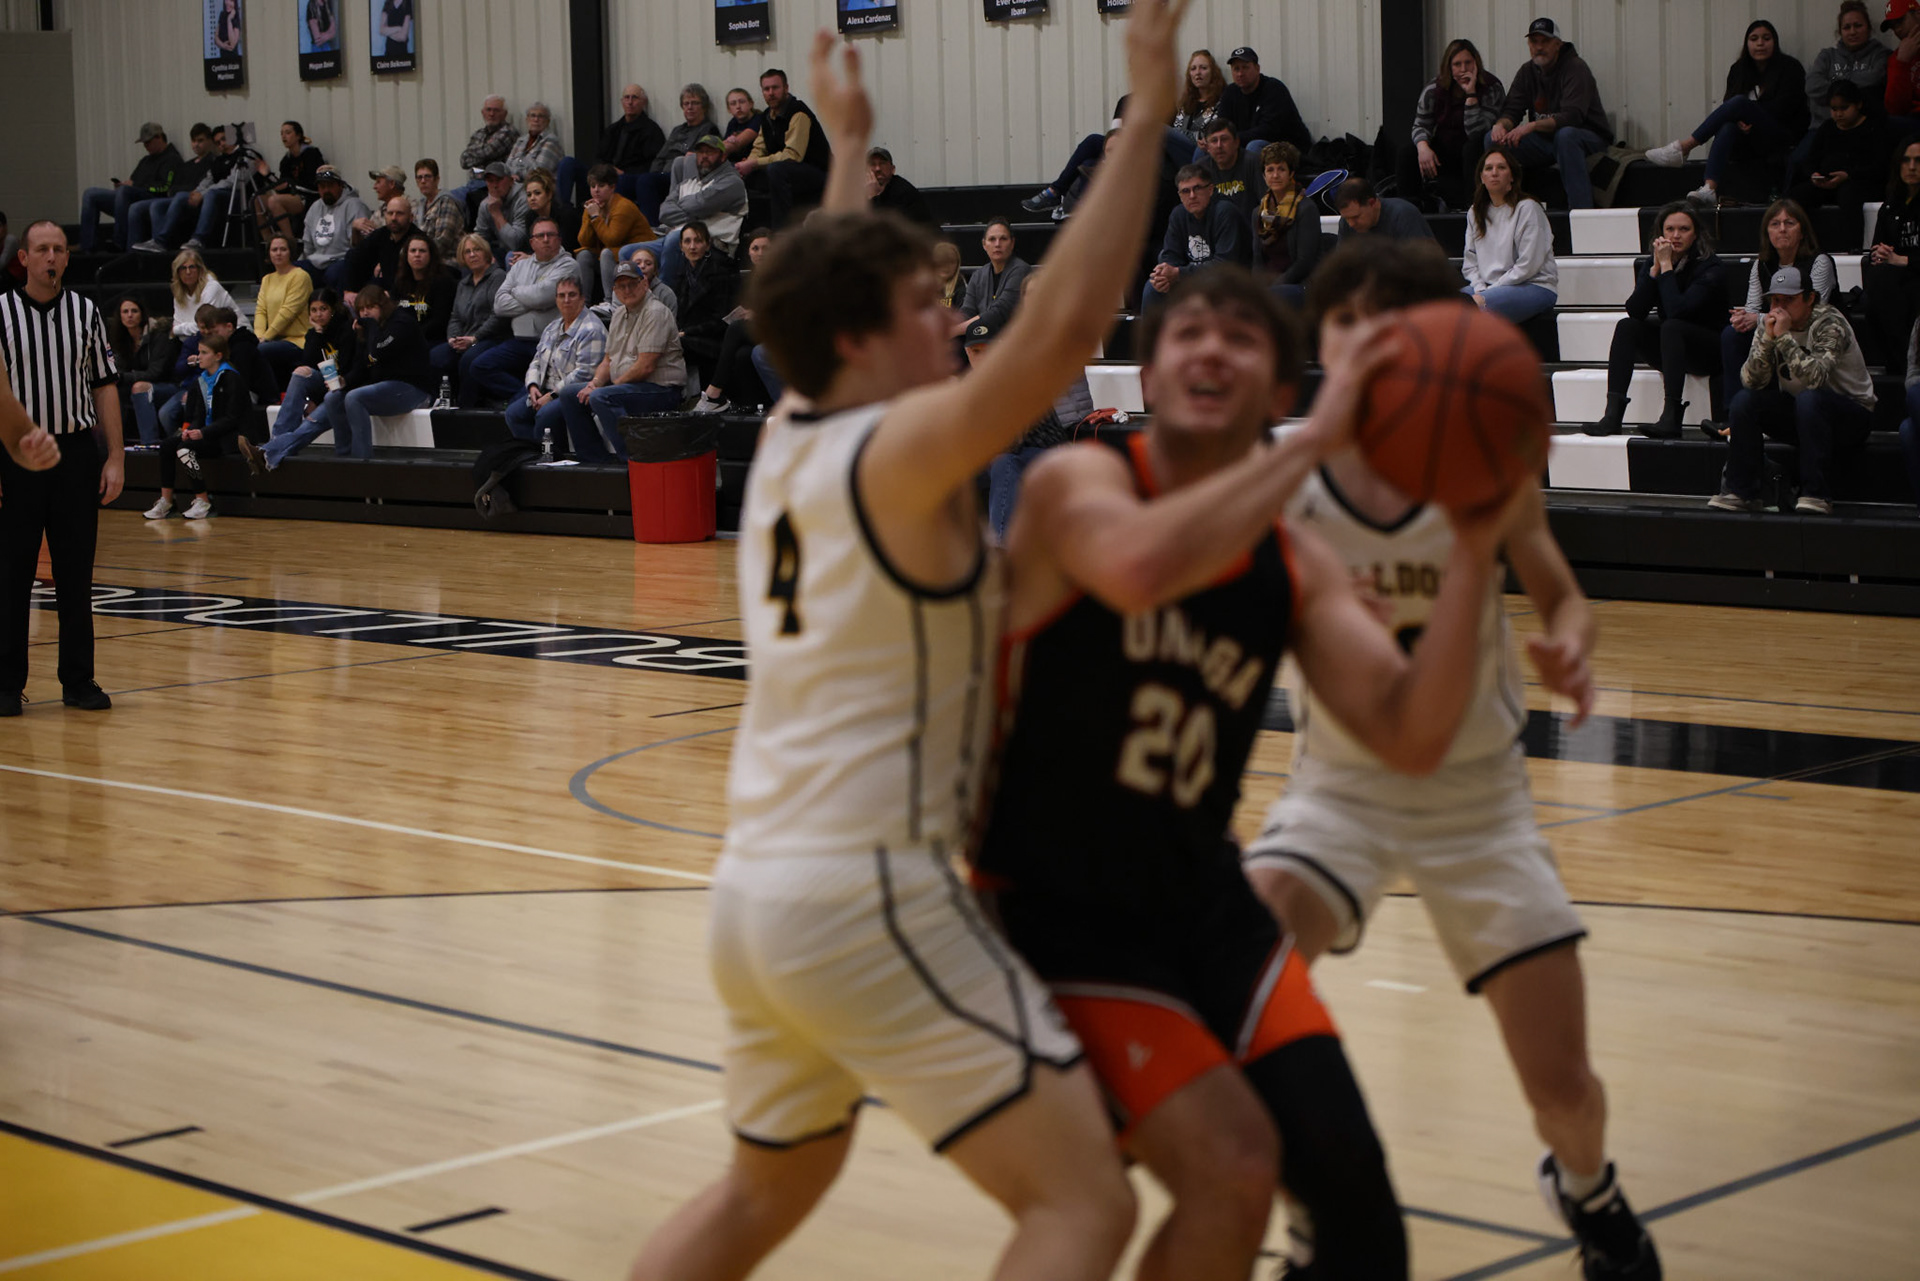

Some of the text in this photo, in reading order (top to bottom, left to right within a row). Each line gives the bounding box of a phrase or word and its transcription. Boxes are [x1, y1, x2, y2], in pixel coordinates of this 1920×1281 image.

[847, 14, 891, 25] Alexa Cardenas
[728, 20, 760, 31] Sophia Bott
[1112, 681, 1218, 811] 20
